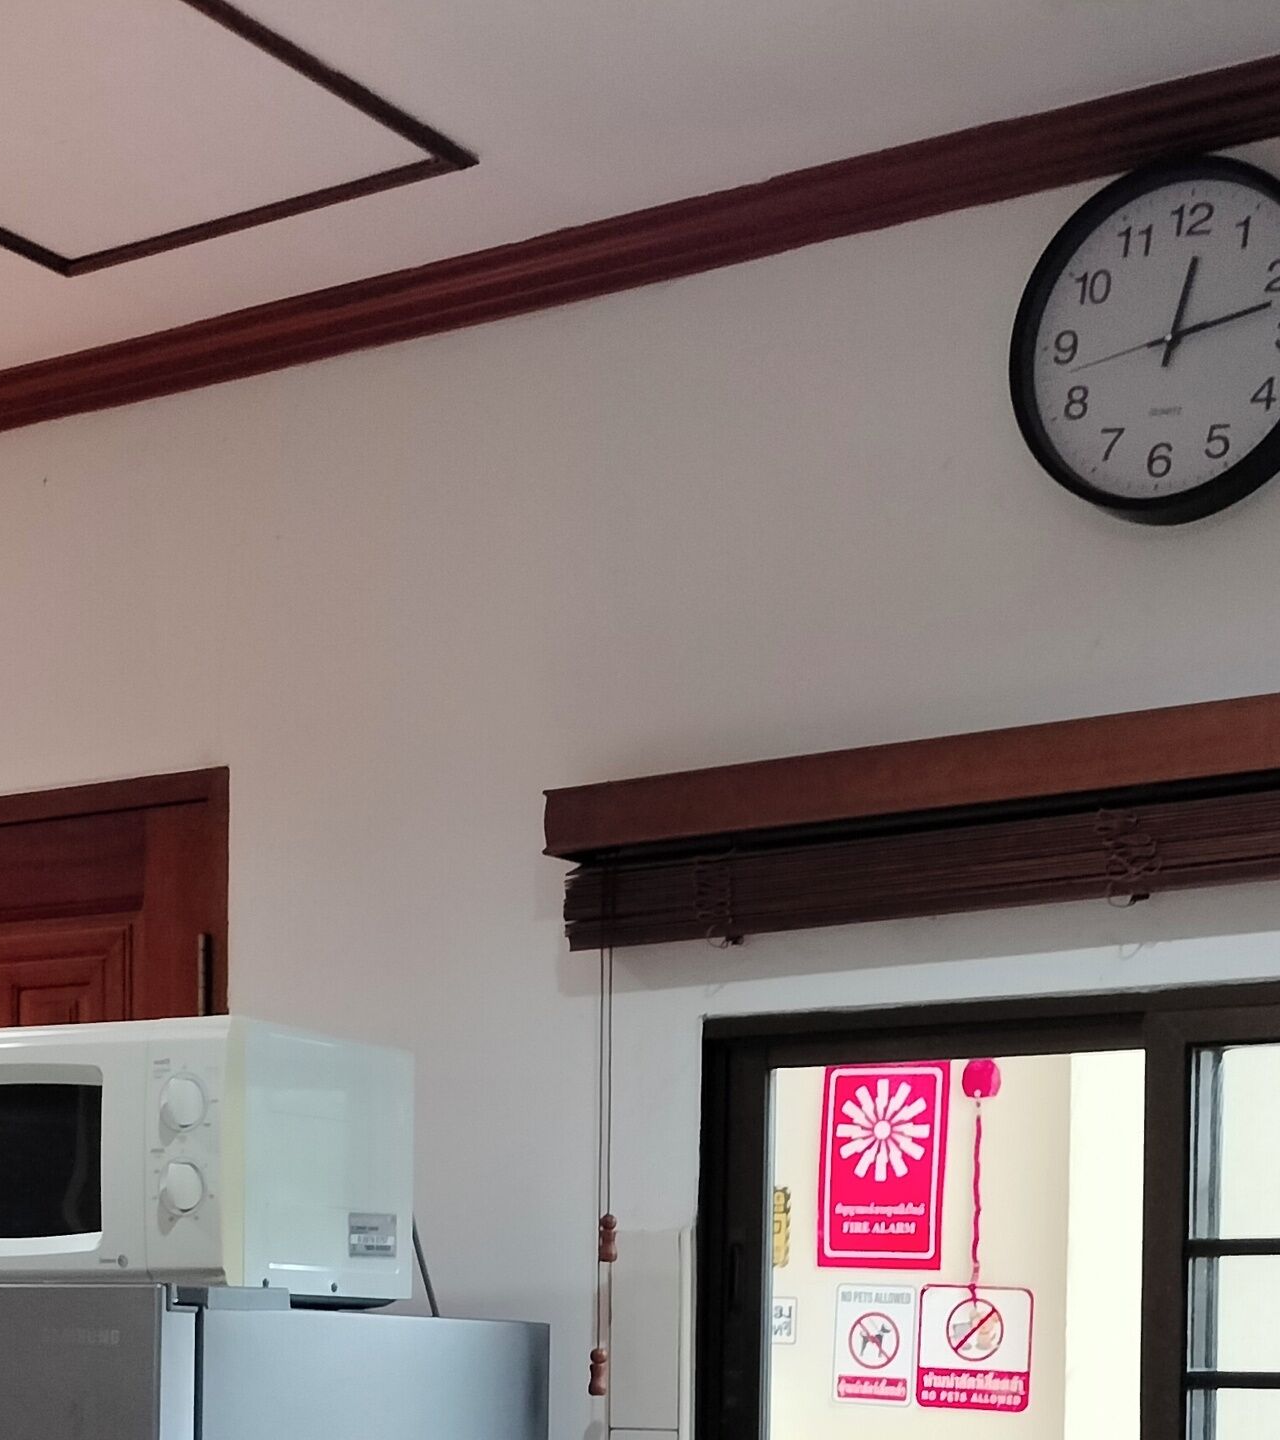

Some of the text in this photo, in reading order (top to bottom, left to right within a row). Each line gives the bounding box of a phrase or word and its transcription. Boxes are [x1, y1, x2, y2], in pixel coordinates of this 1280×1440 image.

[1170, 202, 1214, 237] 12
[1235, 215, 1252, 249] 1
[1117, 224, 1154, 258] 11
[1074, 269, 1112, 305] 10
[1053, 329, 1078, 365] 9
[1063, 385, 1089, 421] 8
[1250, 376, 1277, 412] 4
[1100, 427, 1125, 462] 7
[1204, 423, 1231, 459] 5
[1146, 442, 1173, 478] 6
[842, 1221, 916, 1234] FIRE ALARM
[841, 1291, 911, 1304] NO PETS ALLOWED
[921, 1390, 1022, 1406] NO PETS ALLOWED
